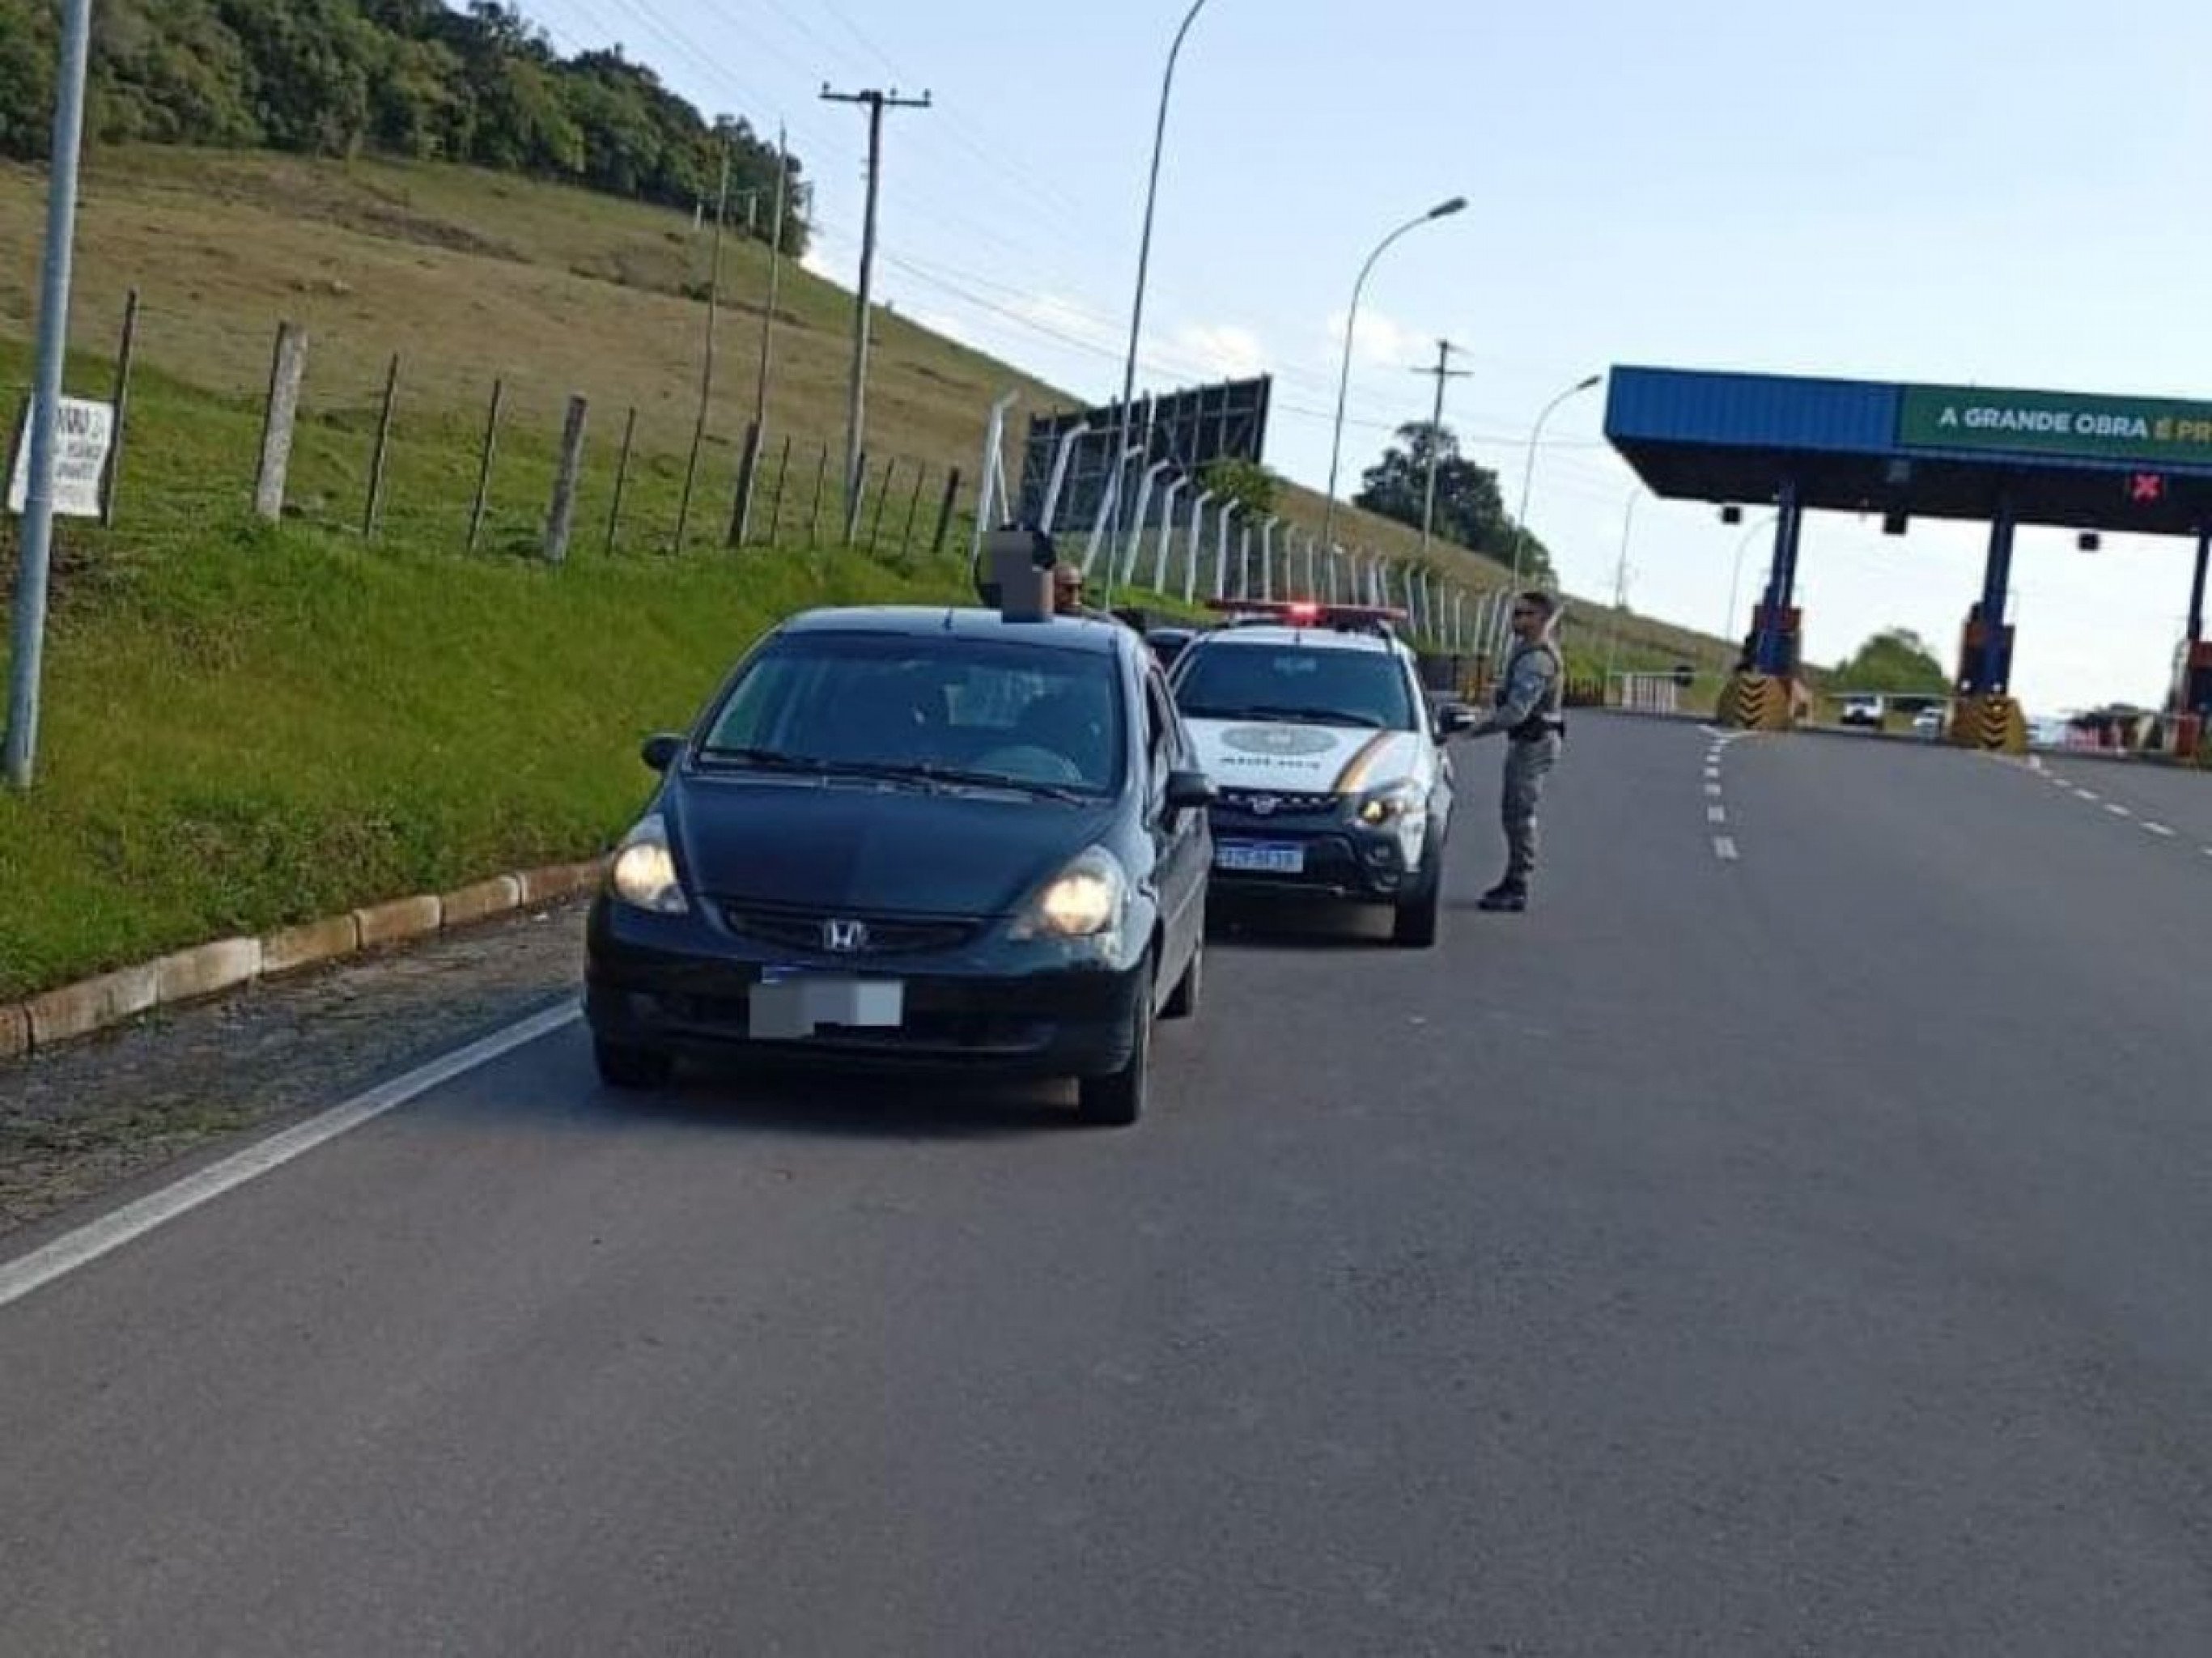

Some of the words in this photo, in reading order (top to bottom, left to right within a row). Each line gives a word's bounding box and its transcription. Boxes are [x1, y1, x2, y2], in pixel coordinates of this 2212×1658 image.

[1938, 407, 1957, 426] A
[1964, 408, 2070, 432] GRANDE
[2076, 413, 2147, 439] OBRA
[2178, 420, 2212, 442] PR
